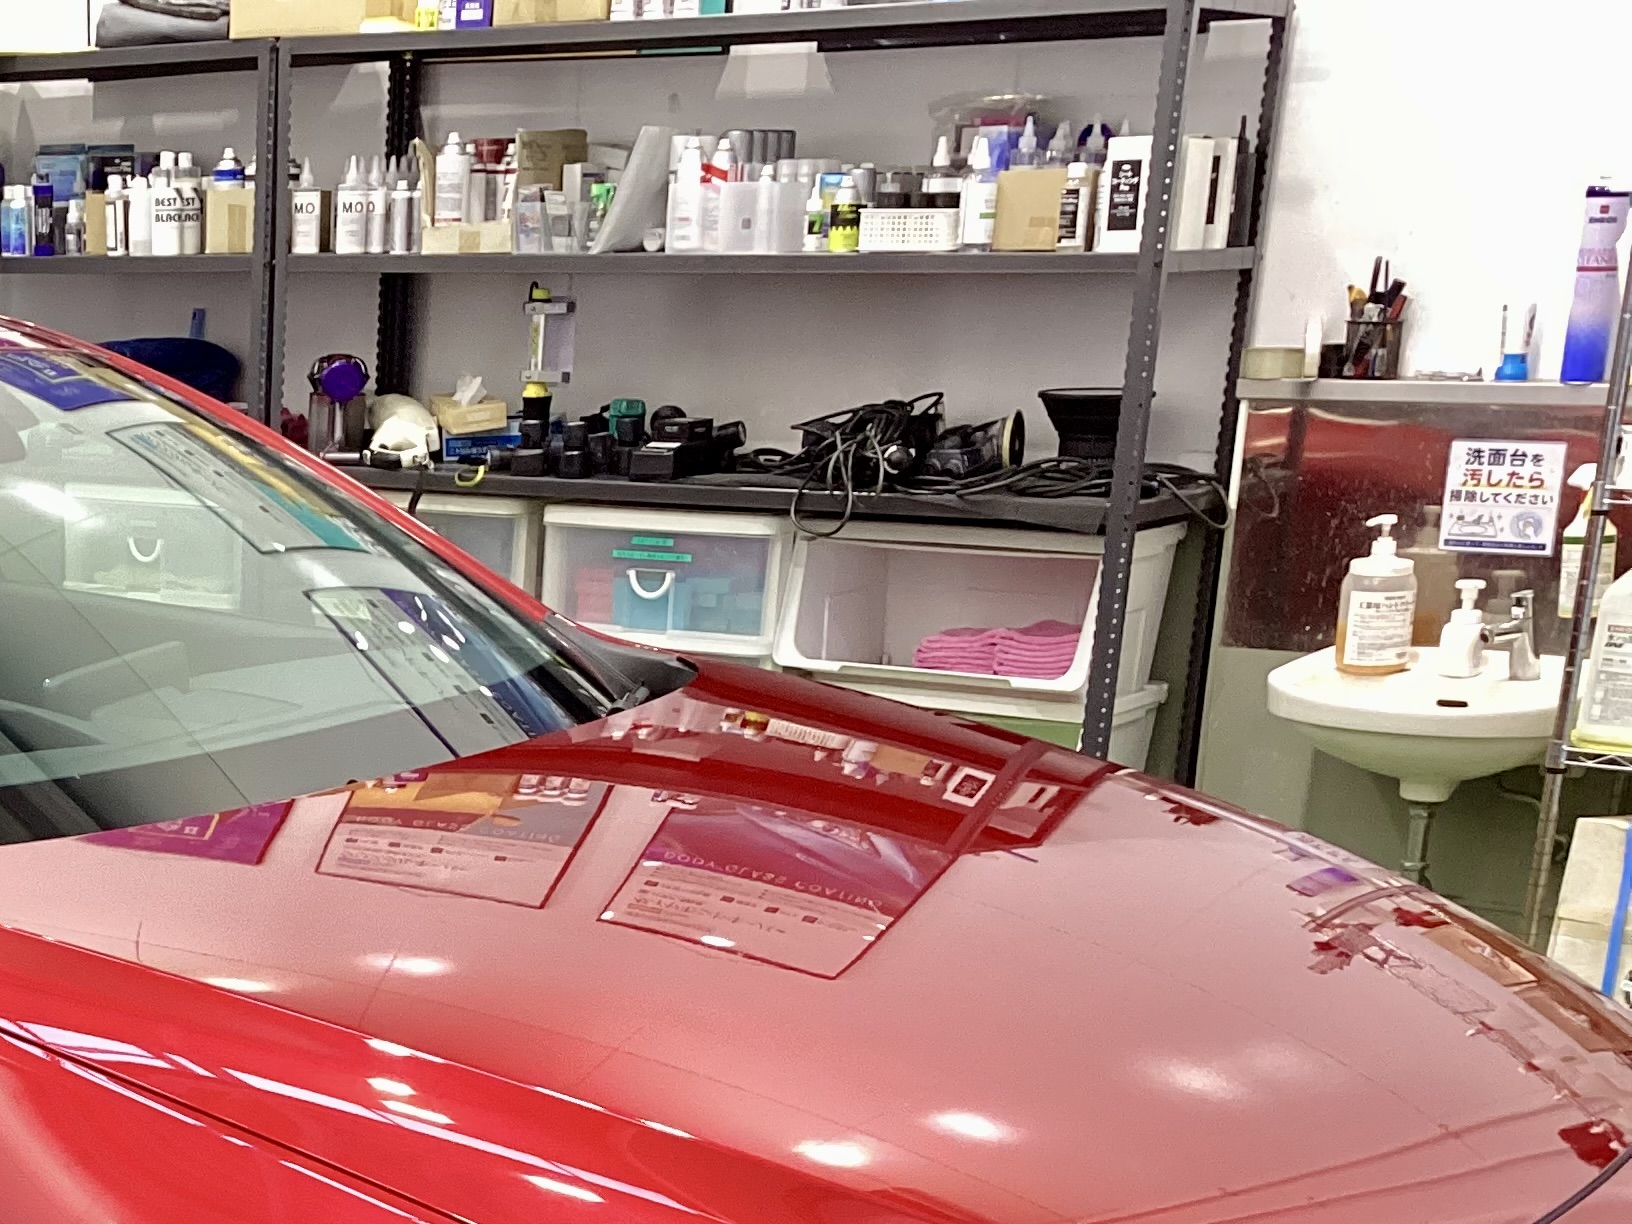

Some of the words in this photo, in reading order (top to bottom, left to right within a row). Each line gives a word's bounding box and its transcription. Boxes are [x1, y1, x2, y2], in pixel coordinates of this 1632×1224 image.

[155, 198, 177, 207] BEST
[1465, 447, 1545, 468] 洗面台を
[1462, 468, 1546, 489] 汚したら
[1449, 489, 1554, 506] 掃除してください
